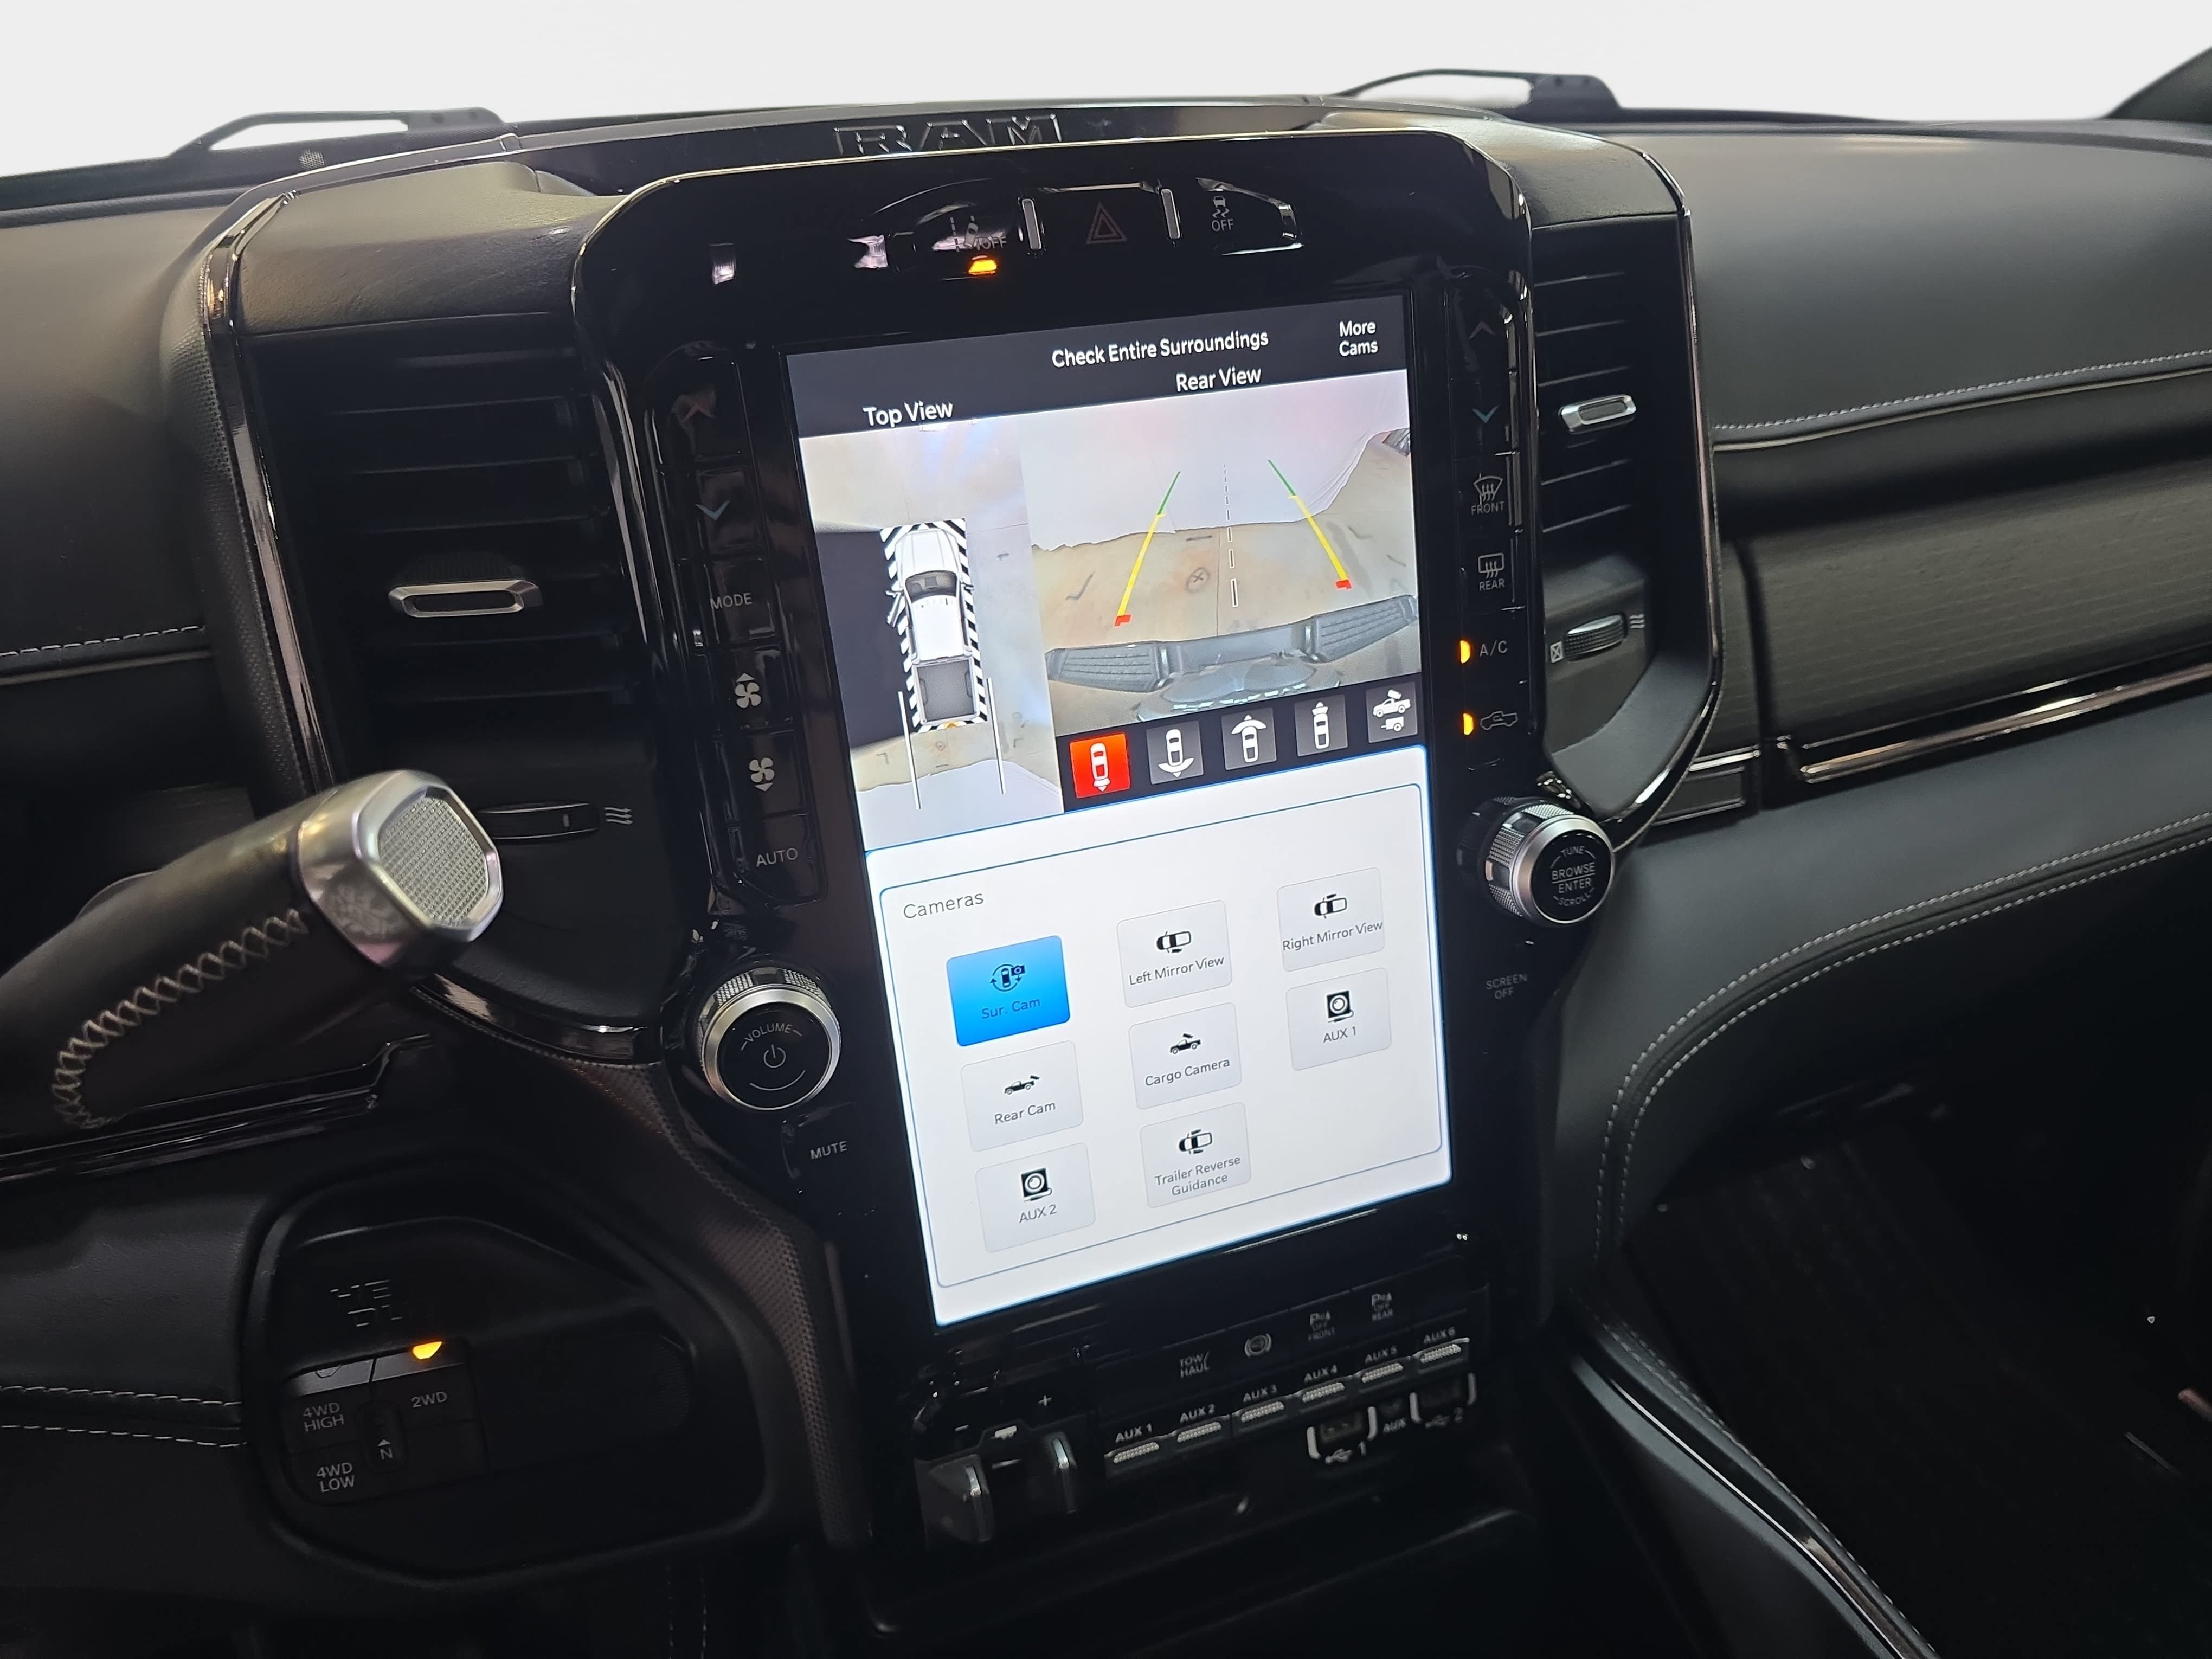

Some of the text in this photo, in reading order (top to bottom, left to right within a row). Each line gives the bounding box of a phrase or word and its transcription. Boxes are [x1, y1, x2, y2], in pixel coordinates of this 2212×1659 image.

[833, 113, 1062, 156] RAM
[1211, 218, 1234, 232] OFF
[1339, 320, 1376, 337] More
[1052, 330, 1269, 369] Check Entire Surroundings
[1339, 338, 1379, 357] Cams
[1176, 366, 1262, 392] Rear View
[863, 399, 954, 428] Top View
[1471, 500, 1505, 516] FRONT
[1479, 578, 1505, 591] REAR
[710, 592, 753, 610] MODE
[1479, 640, 1508, 657] A/C
[756, 847, 798, 868] AUTO
[1561, 845, 1585, 856] TUNE
[1552, 861, 1596, 881] BROWSE
[1558, 878, 1592, 893] ENTER
[903, 892, 984, 919] Cameras
[1558, 892, 1591, 907] SCROLL
[1282, 920, 1383, 951] Right Mirror View
[1129, 955, 1224, 986] Left Mirror View
[1486, 974, 1528, 990] SCREEN
[1494, 987, 1515, 999] OFF
[981, 996, 1041, 1020] Sur. Cam
[743, 1023, 793, 1043] VOLUME
[1322, 1026, 1357, 1043] AUX 1
[1145, 1058, 1231, 1087] Cargo Camera
[994, 1100, 1056, 1125] Rear Cam
[809, 1140, 848, 1160] MUTE
[1154, 1155, 1241, 1187] Trailer Reverse
[1171, 1174, 1229, 1196] Guidance
[1018, 1203, 1057, 1223] AUX 2
[1424, 1330, 1445, 1345] AUX
[1180, 1351, 1210, 1368] TOW/
[1365, 1348, 1388, 1364] AUX
[1180, 1362, 1210, 1378] HAUL
[1303, 1364, 1338, 1383] AUX 4
[411, 1391, 447, 1408] 2WD
[1243, 1384, 1277, 1402] AUX 3
[303, 1402, 340, 1419] 4WD
[1180, 1404, 1216, 1423] AUX 2
[304, 1414, 344, 1432] HIGH
[1383, 1417, 1406, 1433] AUX
[1115, 1422, 1153, 1444] AUX 1
[380, 1447, 393, 1461] N
[1359, 1441, 1366, 1457] 1
[316, 1462, 353, 1478] 4WD
[320, 1475, 355, 1493] LOW
